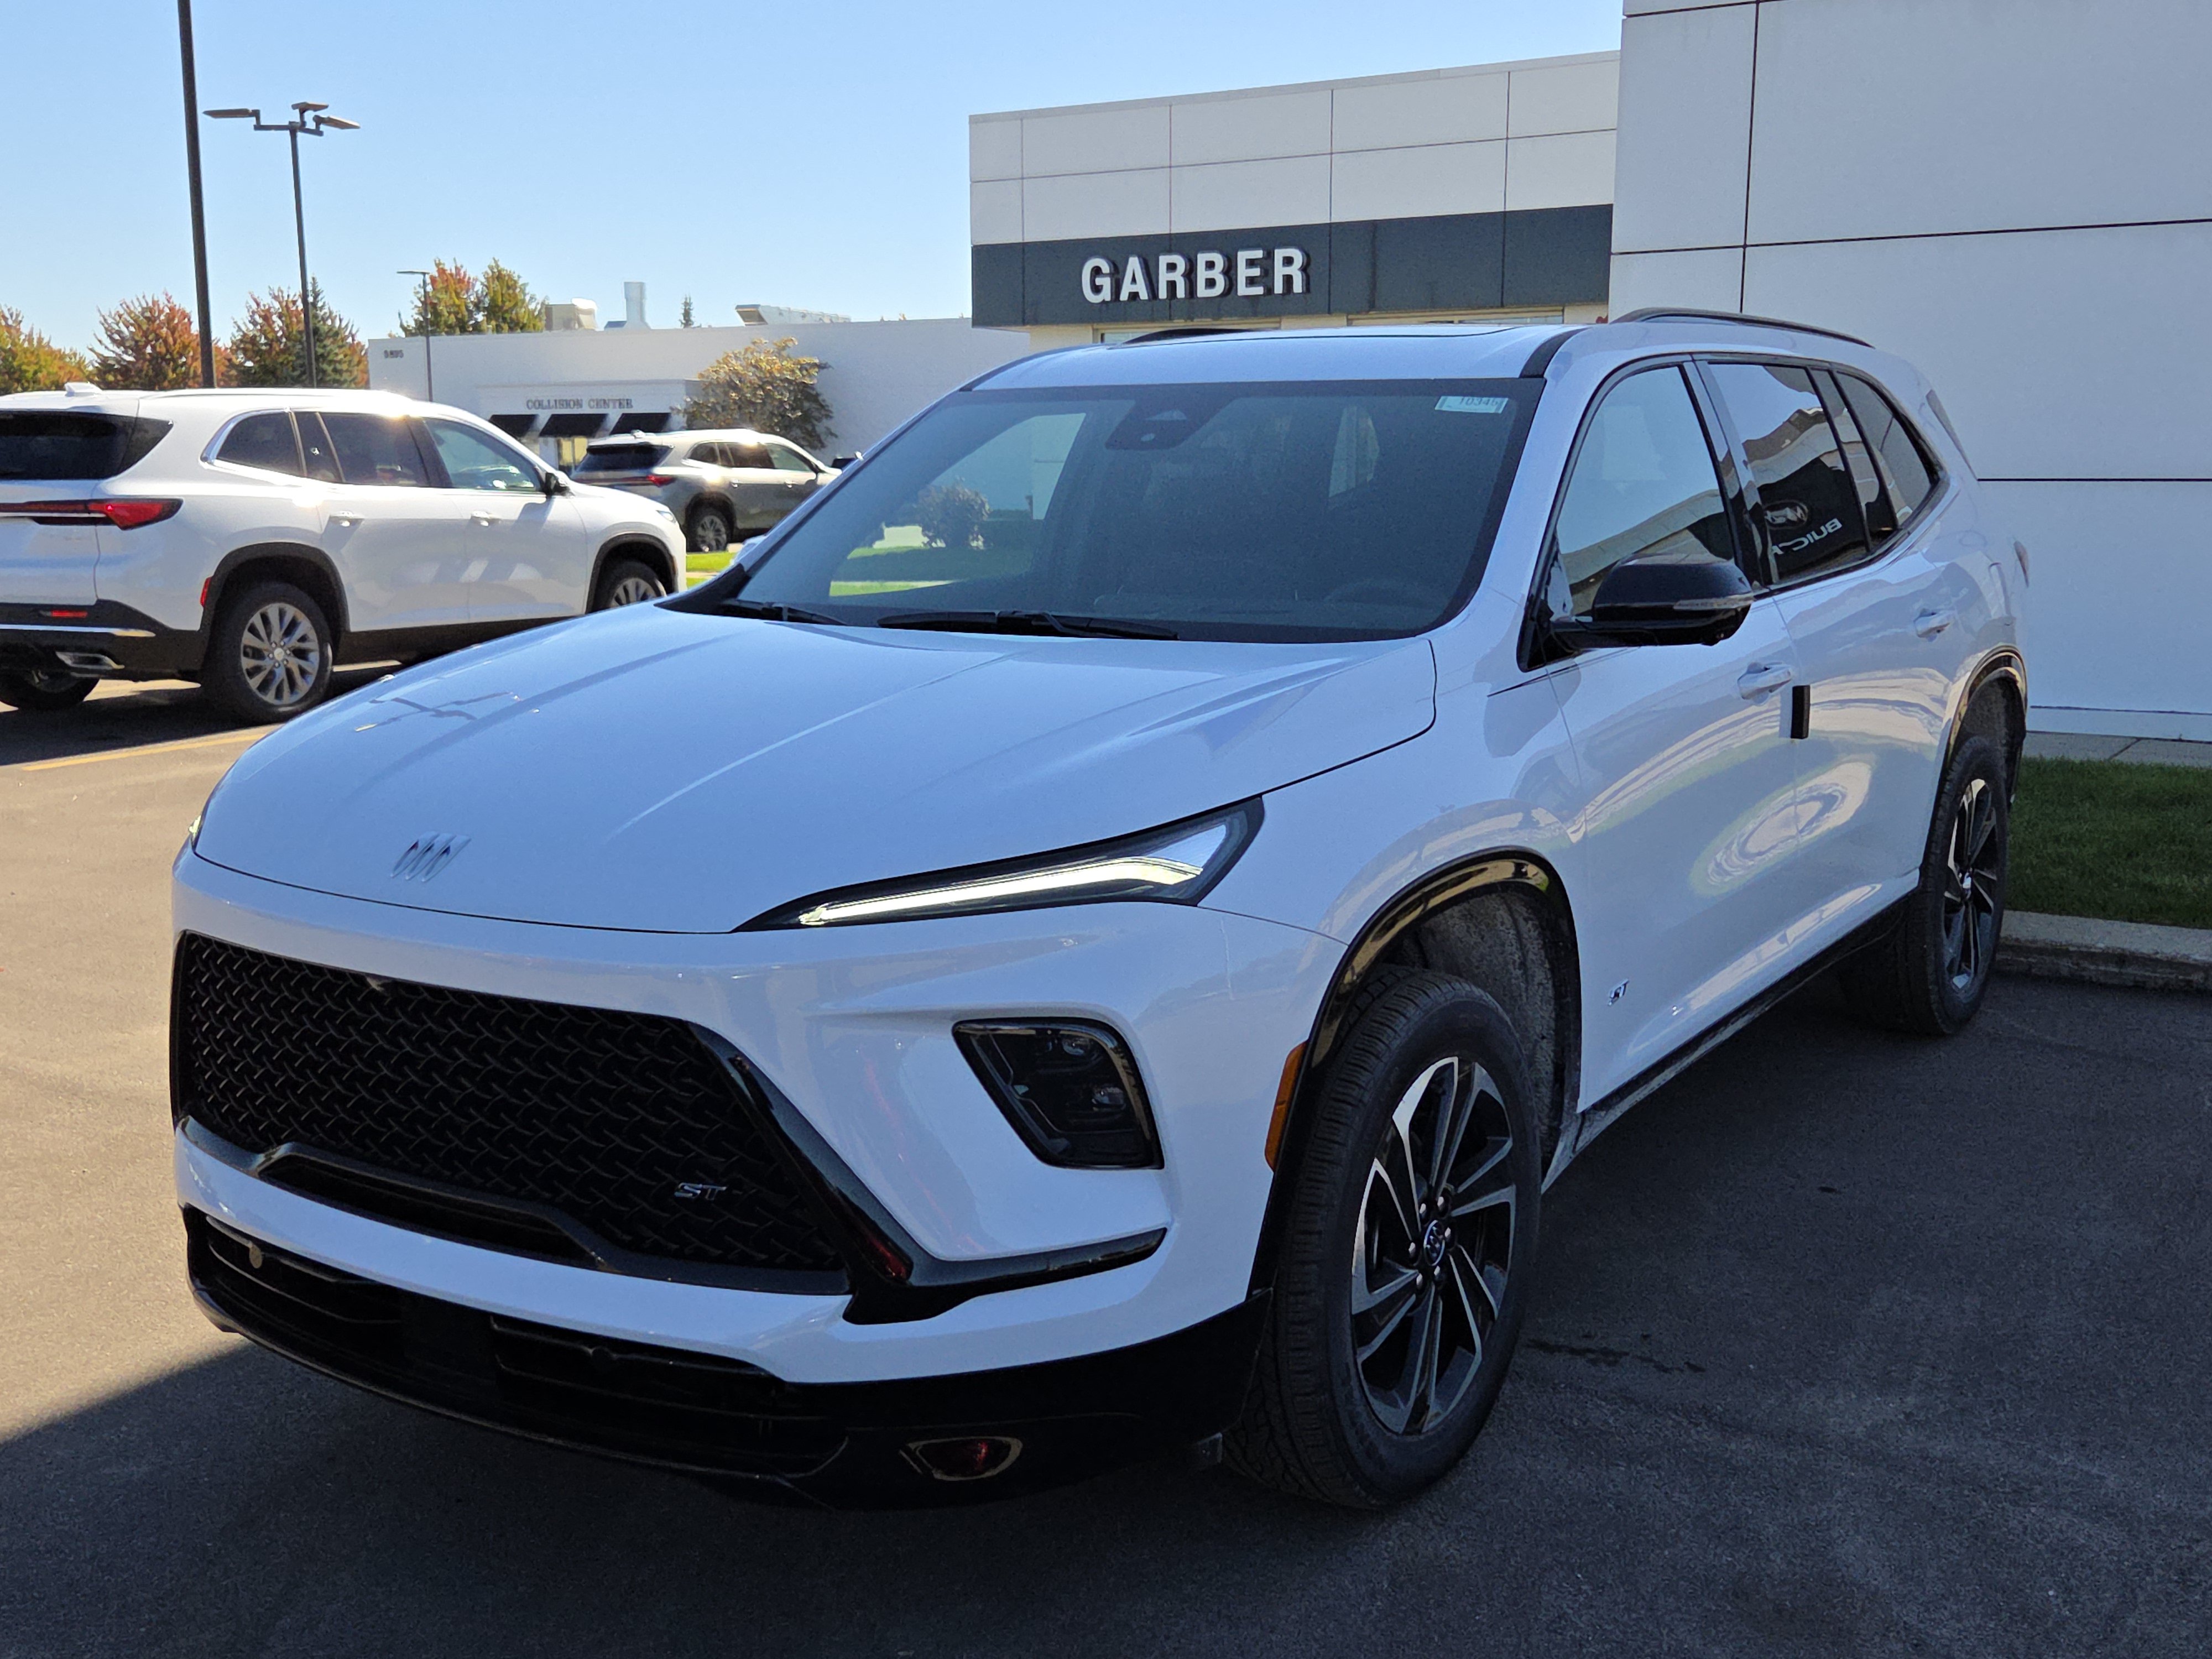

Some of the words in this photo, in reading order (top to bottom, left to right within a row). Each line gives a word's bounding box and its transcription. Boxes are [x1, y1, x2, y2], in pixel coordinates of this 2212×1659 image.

[1081, 248, 1309, 304] GARBER
[526, 398, 583, 410] COLLISION
[588, 398, 634, 409] CENTER
